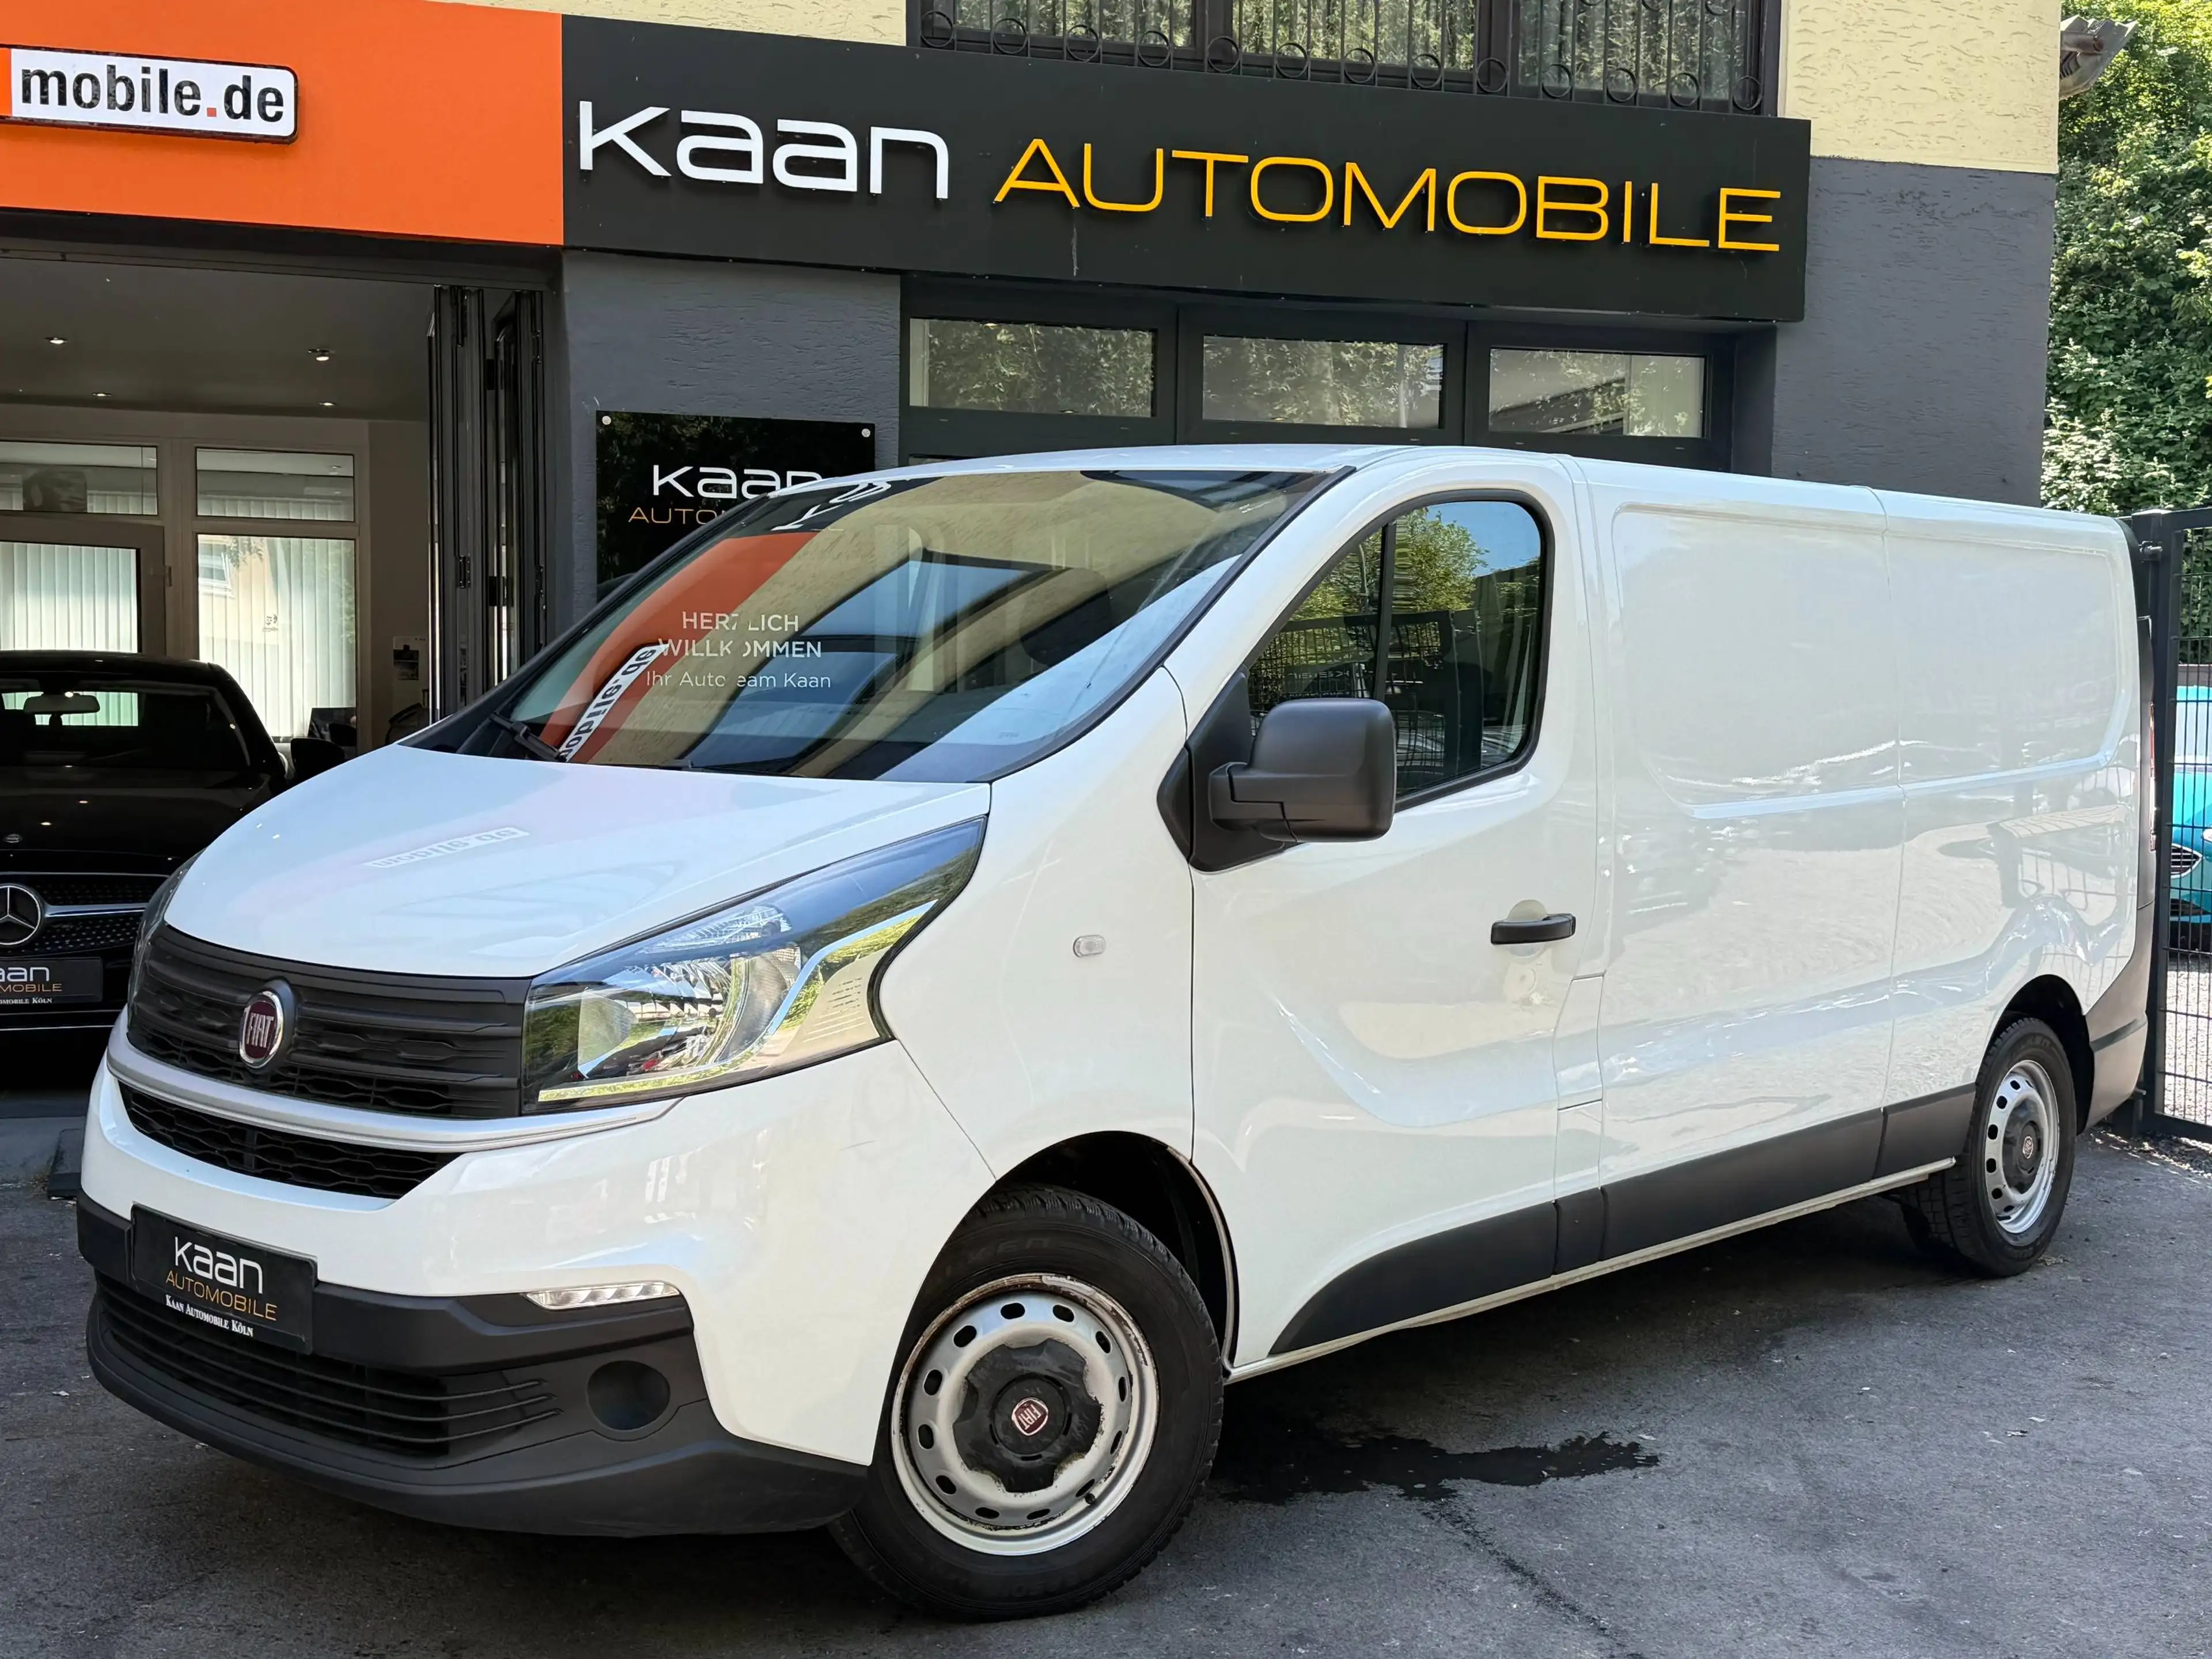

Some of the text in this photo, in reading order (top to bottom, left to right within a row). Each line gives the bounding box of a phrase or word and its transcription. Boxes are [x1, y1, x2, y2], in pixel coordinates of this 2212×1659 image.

[21, 65, 284, 122] mobile.de
[993, 139, 1781, 251] AUTOMOBILE
[627, 507, 726, 525] AUTO
[647, 671, 672, 686] Ihr
[785, 673, 831, 688] Kaan
[246, 1012, 274, 1048] FIAT
[166, 1270, 278, 1321] AUTOMOBILE
[1017, 1403, 1042, 1430] FIAT
